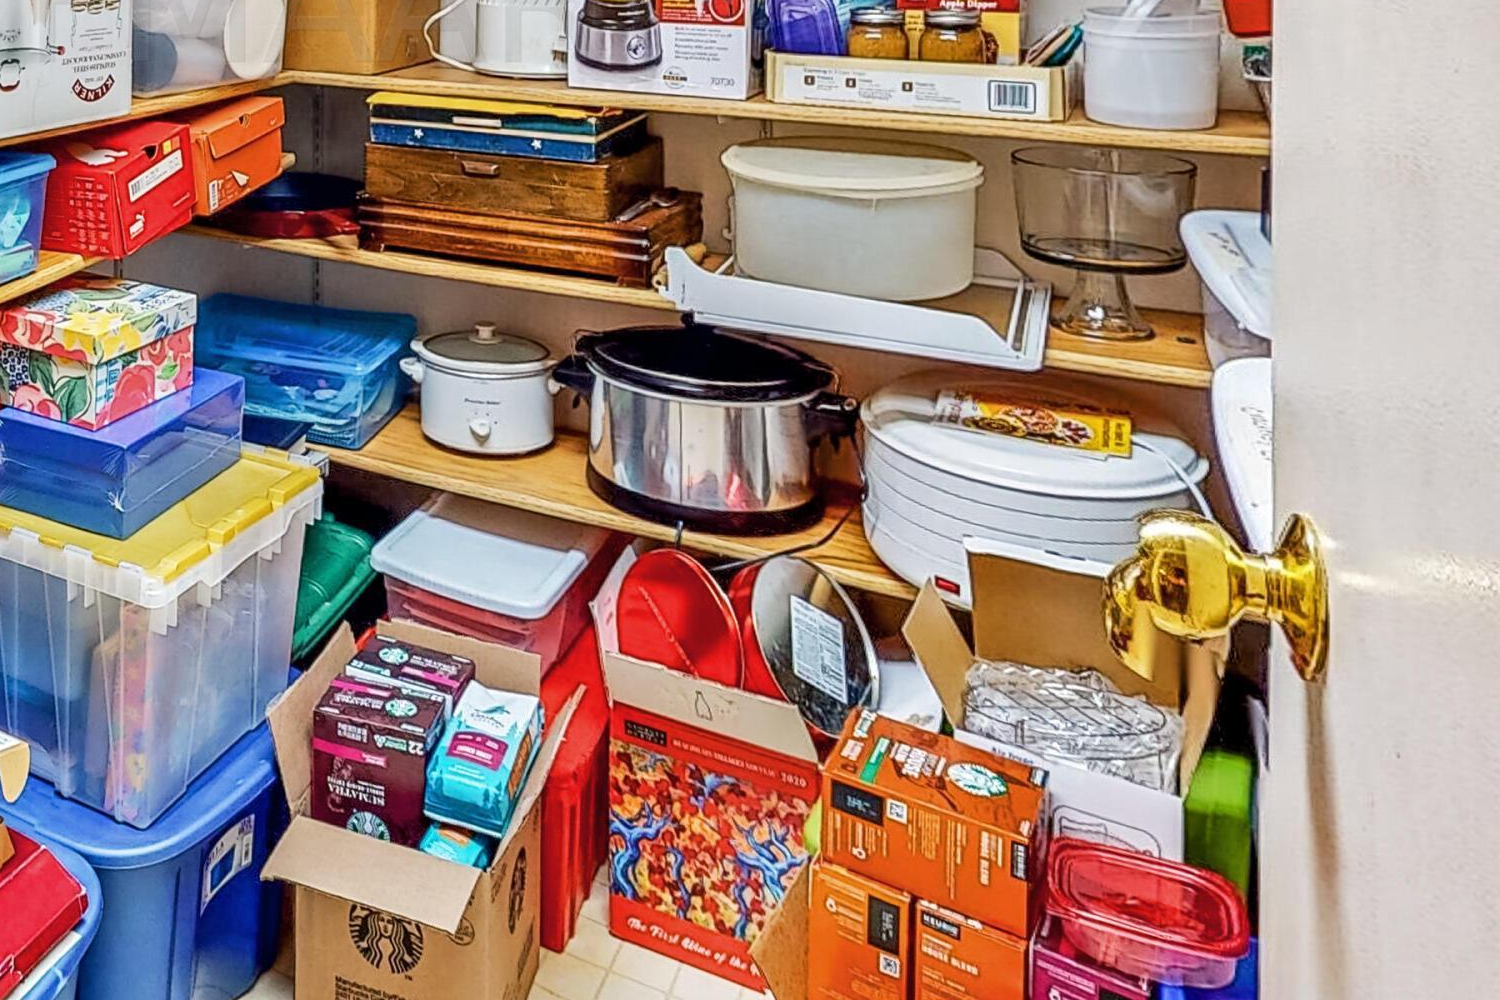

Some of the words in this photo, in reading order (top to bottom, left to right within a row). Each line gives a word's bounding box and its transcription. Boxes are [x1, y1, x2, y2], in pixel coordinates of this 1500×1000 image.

[940, 0, 965, 9] Apple
[73, 77, 113, 101] KILNER
[328, 783, 385, 807] SUMATRA
[649, 924, 680, 946] First
